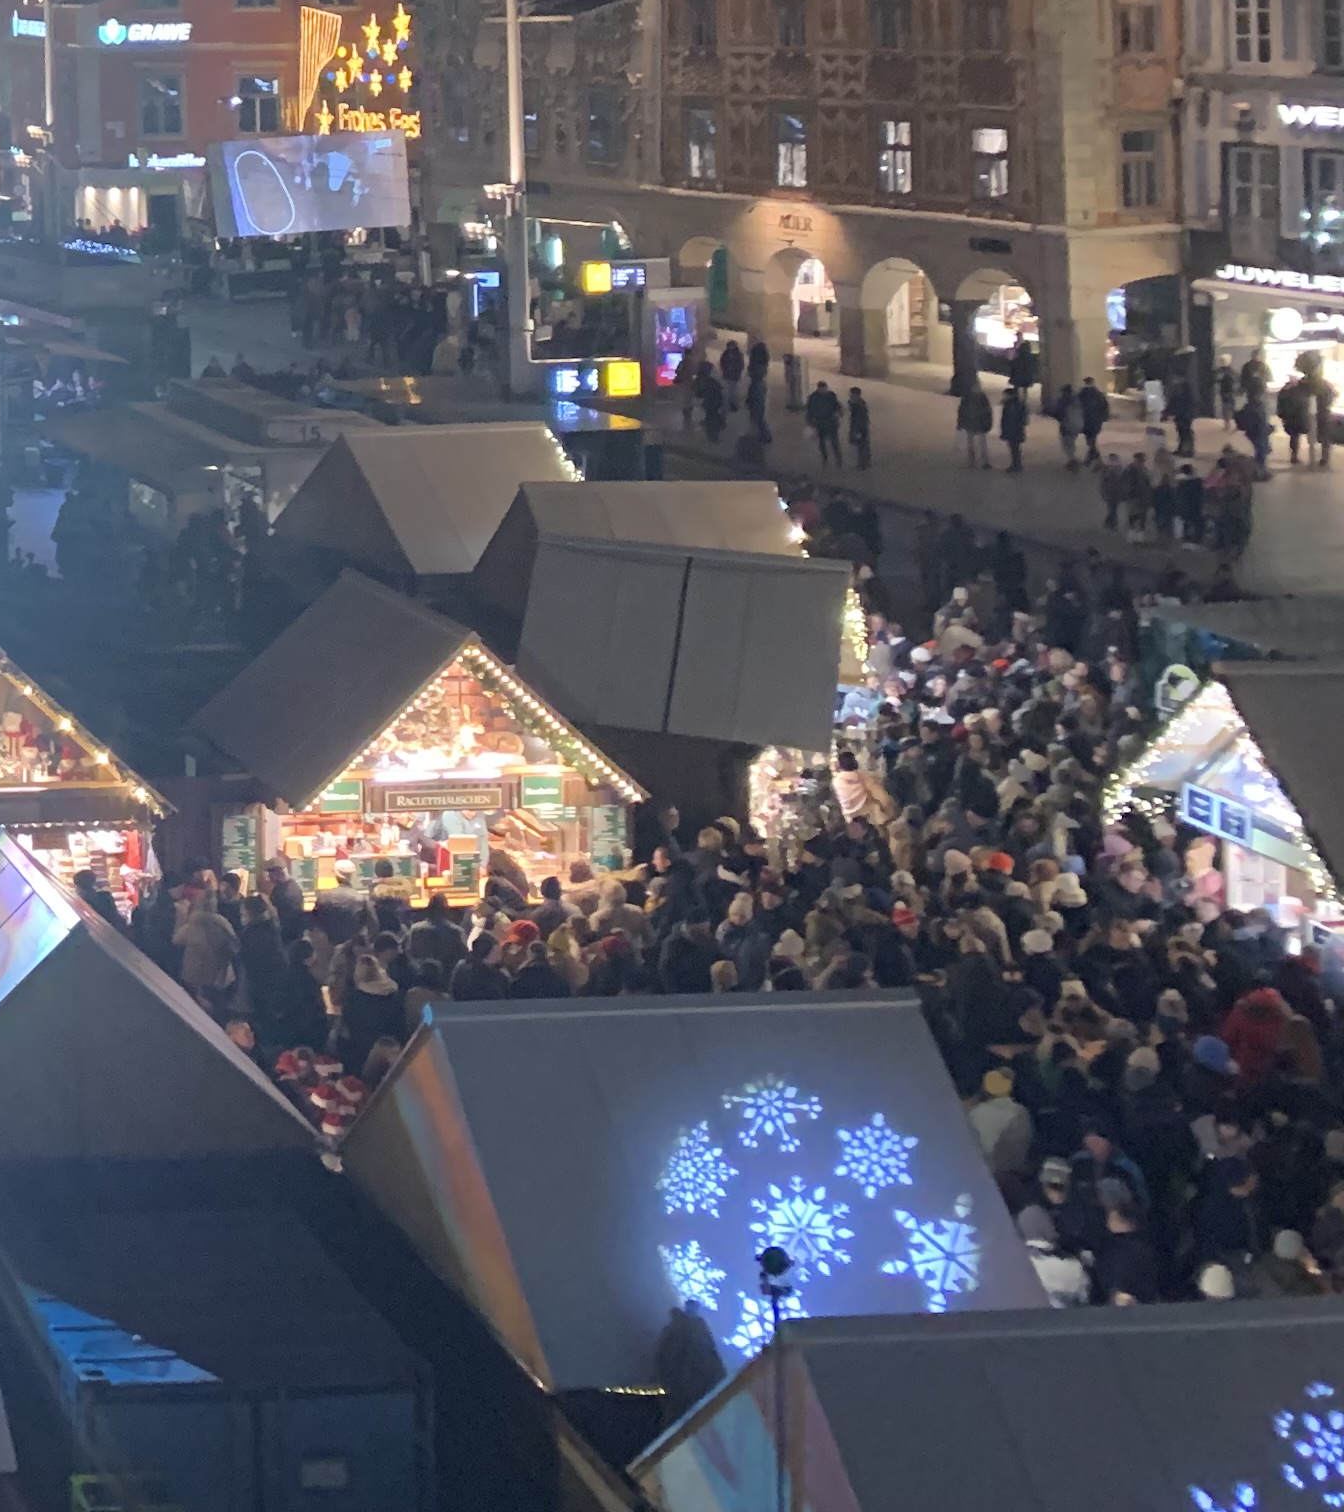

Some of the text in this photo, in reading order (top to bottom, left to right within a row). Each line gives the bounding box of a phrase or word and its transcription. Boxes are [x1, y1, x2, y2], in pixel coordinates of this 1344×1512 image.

[128, 23, 192, 41] GRAWE
[1276, 104, 1344, 126] WE
[1215, 263, 1344, 292] JUWELIE
